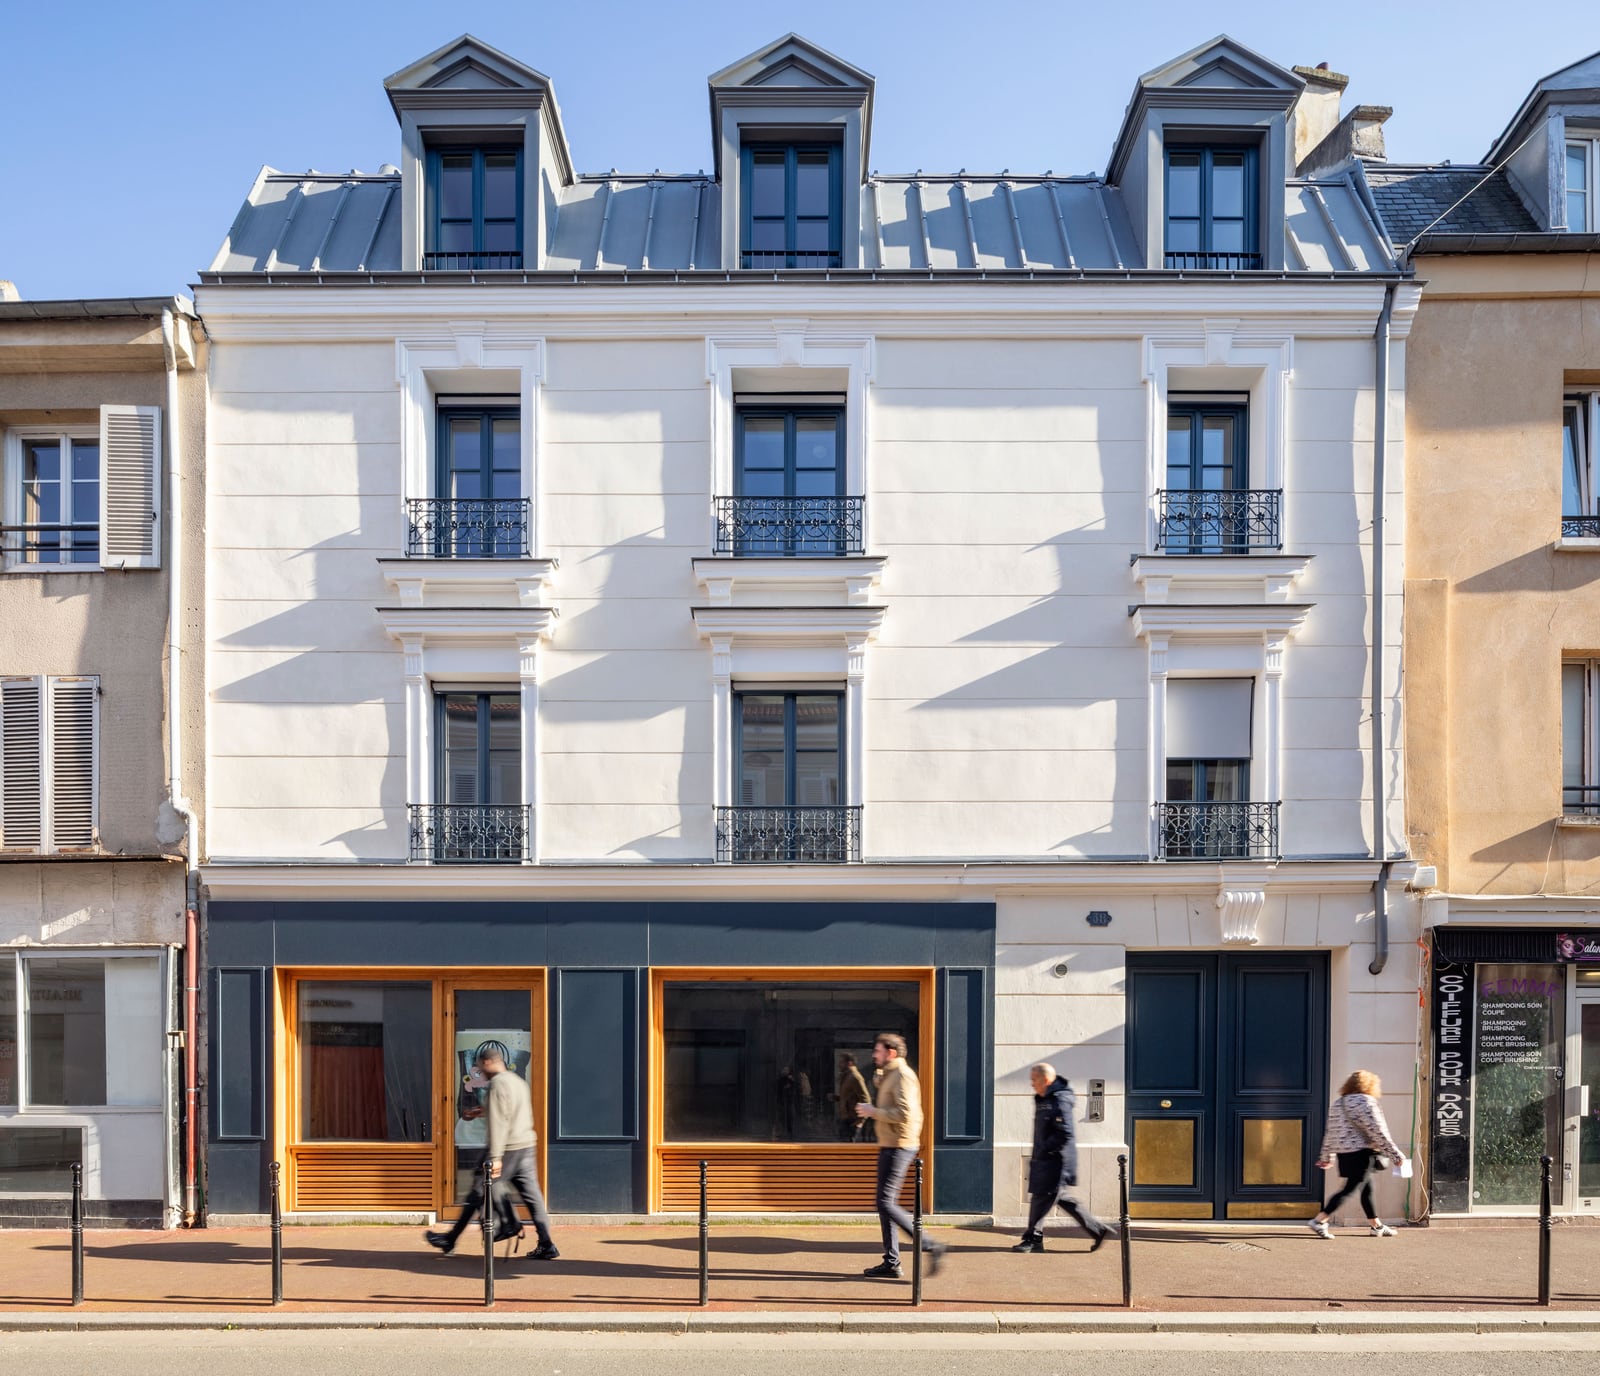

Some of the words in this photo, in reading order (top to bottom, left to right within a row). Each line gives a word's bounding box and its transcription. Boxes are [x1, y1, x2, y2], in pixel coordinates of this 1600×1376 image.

[1481, 977, 1561, 1000] FEMME
[1439, 975, 1464, 1044] COIFFURE
[1438, 1051, 1464, 1086] POUR
[1437, 1093, 1463, 1136] DAMES
